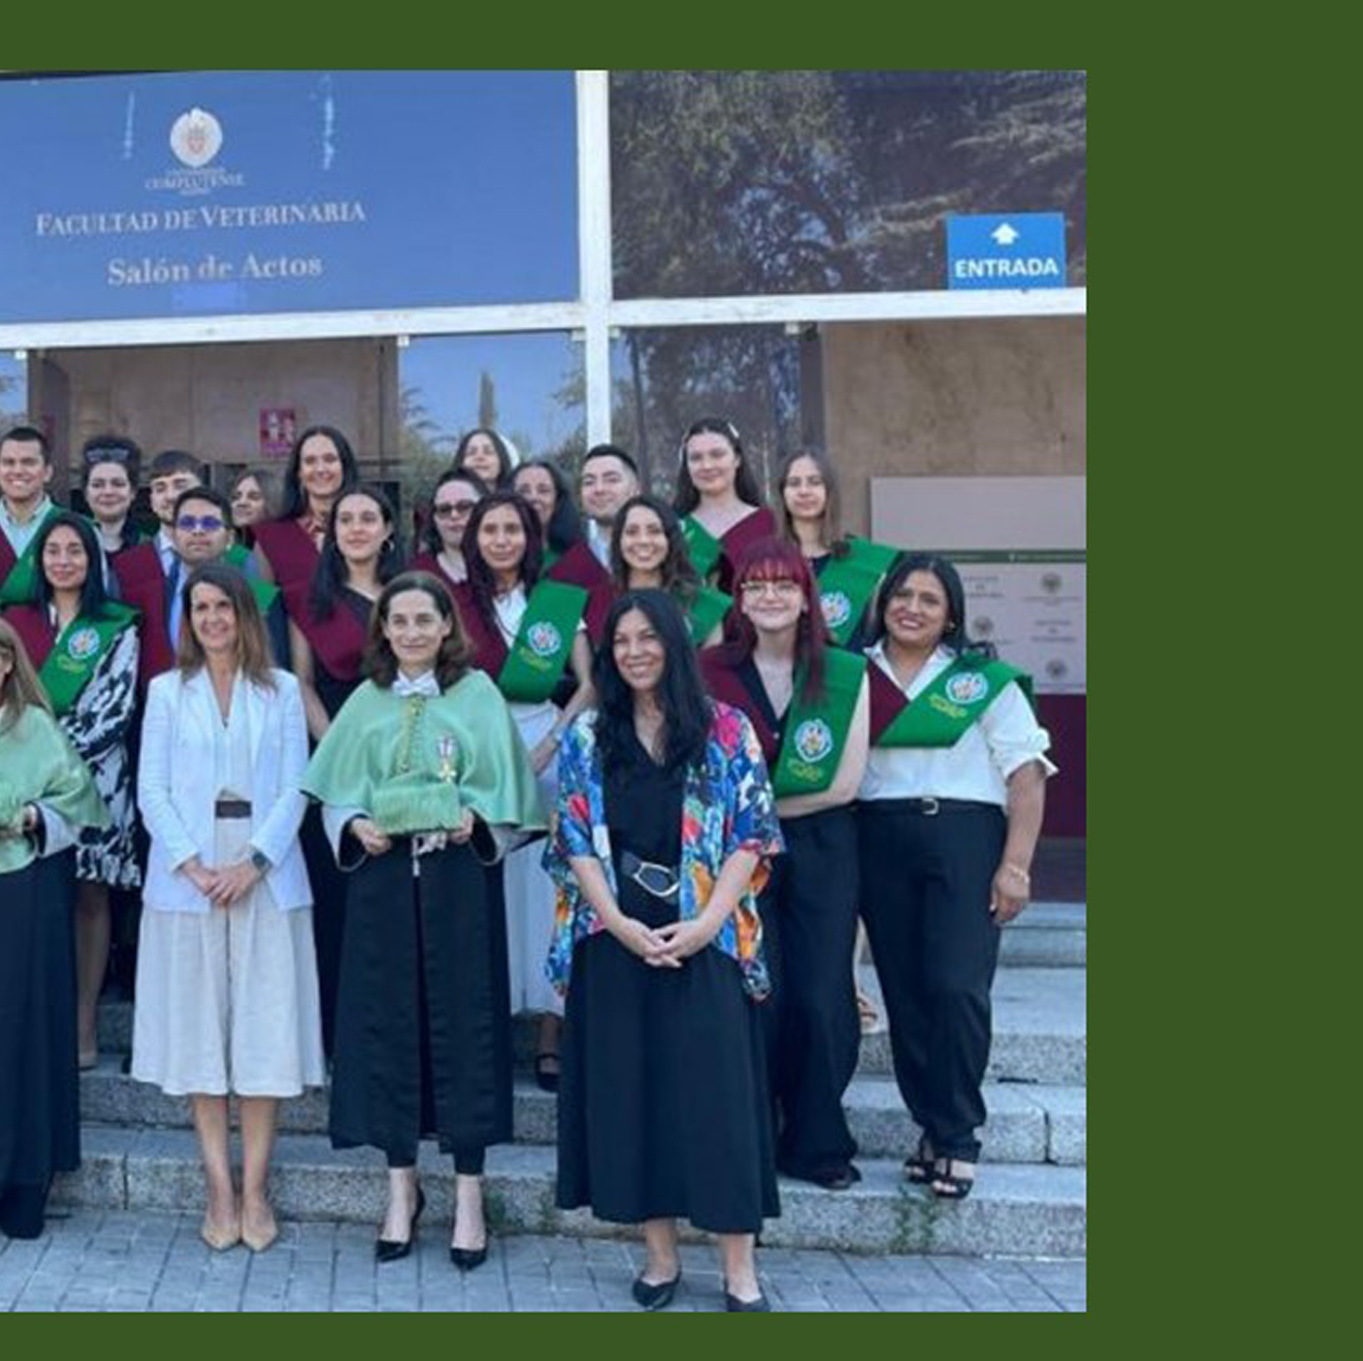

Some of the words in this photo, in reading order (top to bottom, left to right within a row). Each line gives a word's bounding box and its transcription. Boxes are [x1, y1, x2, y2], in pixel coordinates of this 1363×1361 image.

[36, 211, 158, 237] FACULTAD
[164, 209, 199, 231] DE
[203, 201, 367, 227] VETERINARIA
[108, 255, 190, 286] Salón
[197, 255, 234, 281] de
[242, 254, 324, 279] Actos
[955, 257, 1059, 279] ENTRADA
